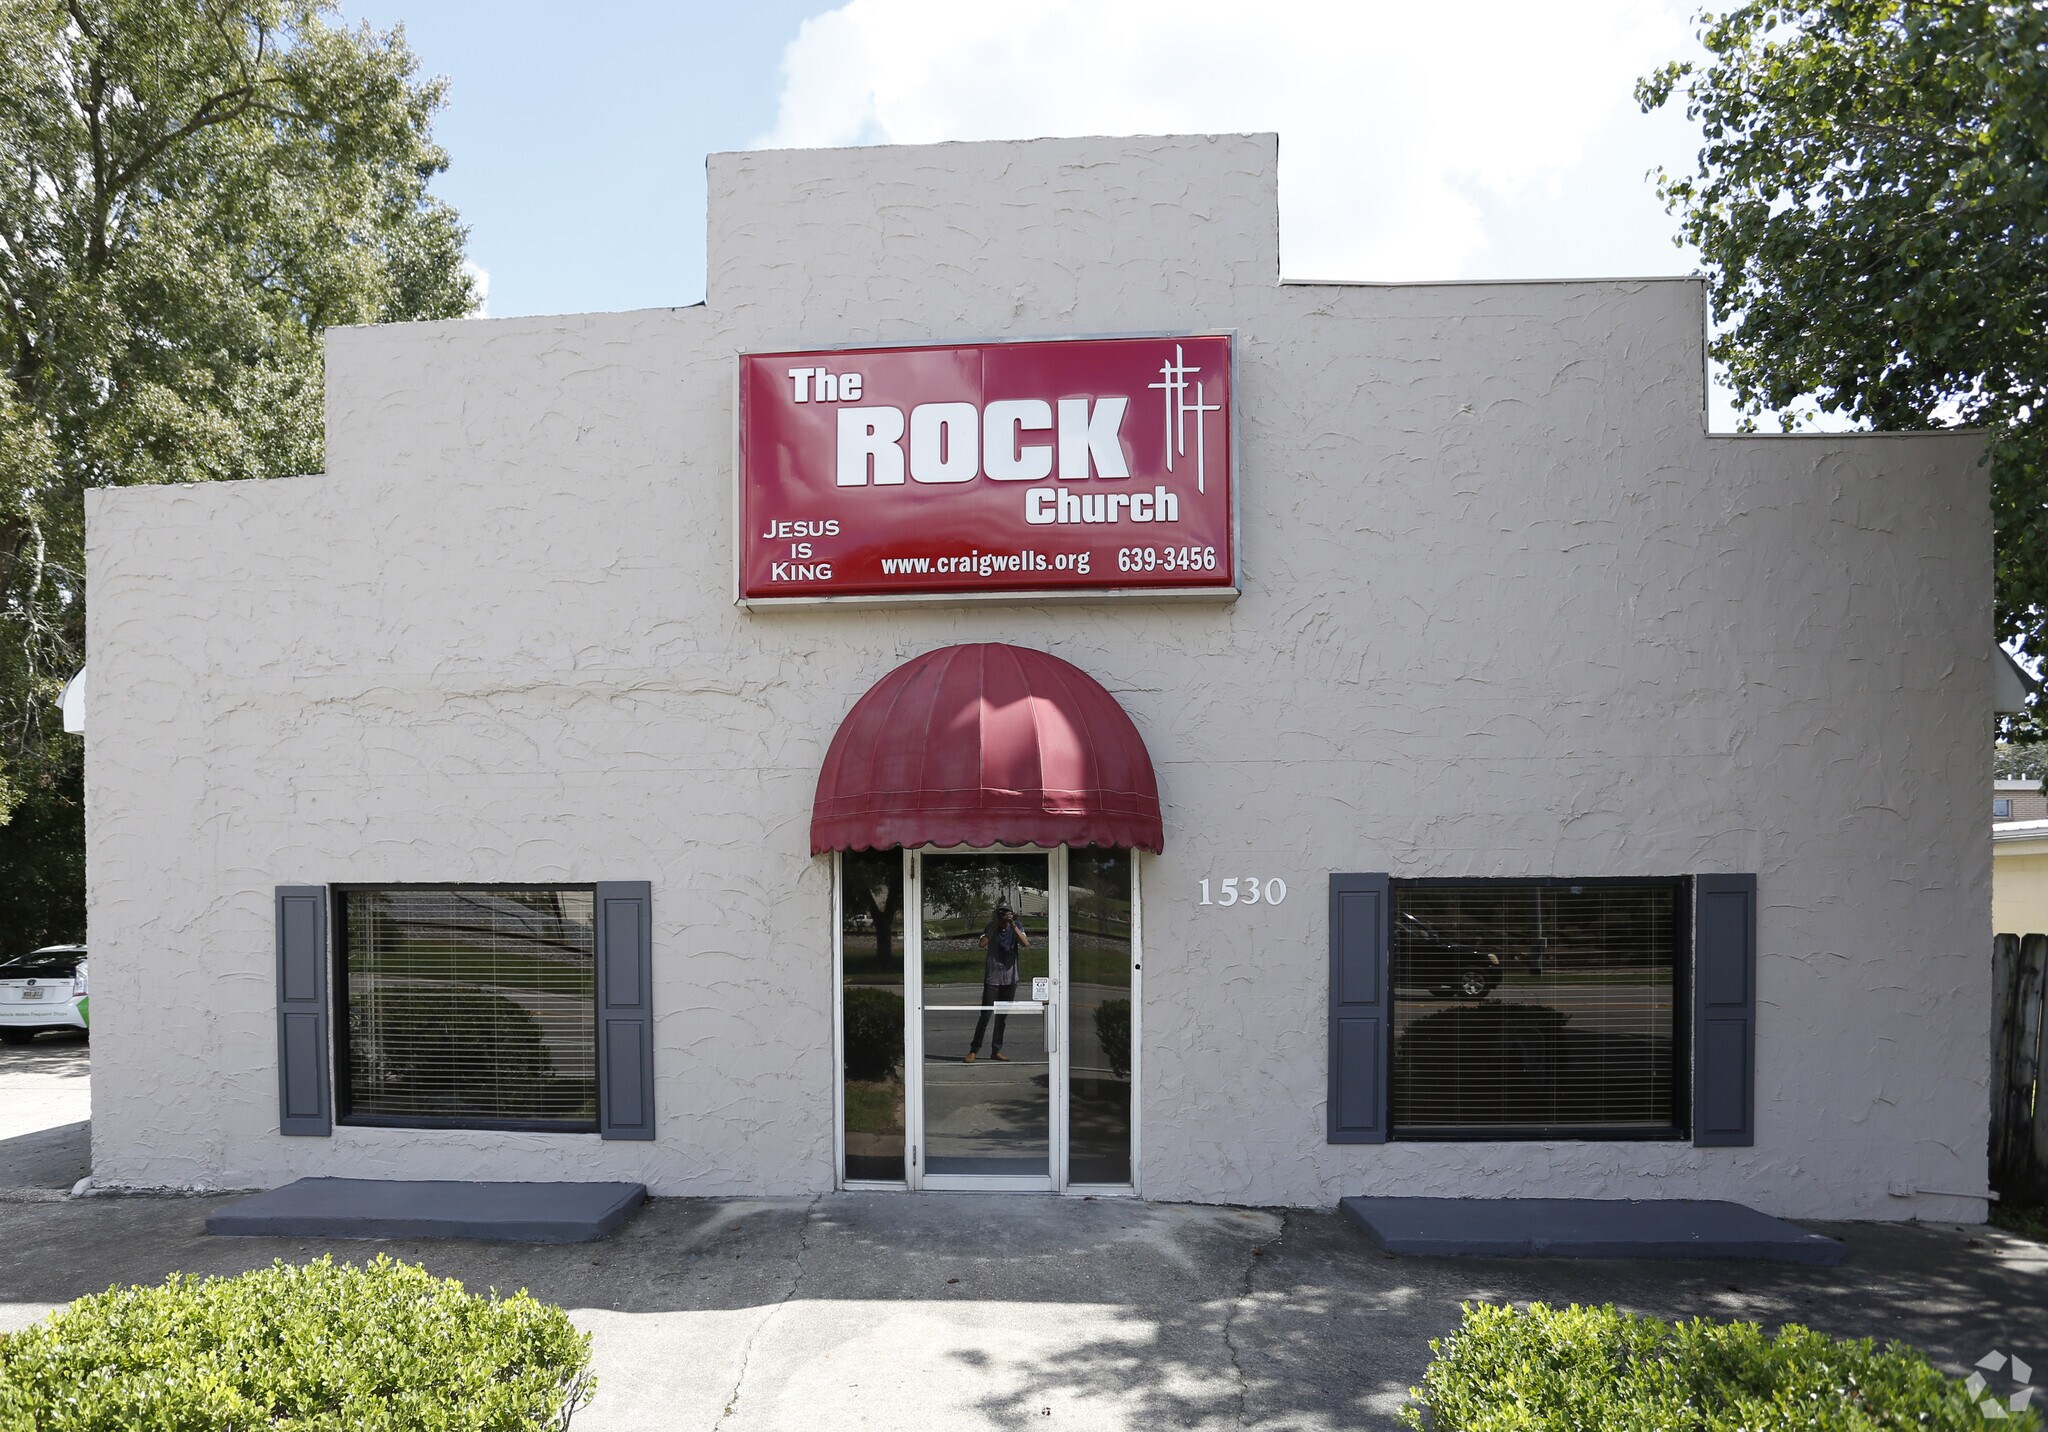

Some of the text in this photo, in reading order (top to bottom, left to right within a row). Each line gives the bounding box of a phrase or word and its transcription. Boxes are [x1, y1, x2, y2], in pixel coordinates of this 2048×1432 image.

[788, 367, 862, 403] The
[836, 396, 1131, 487] ROCK
[1025, 485, 1179, 525] Church
[763, 519, 840, 539] JESUS
[791, 542, 813, 559] IS
[881, 550, 1090, 577] www.craigwells.org
[1117, 546, 1216, 573] 639-3456
[771, 562, 832, 581] KING
[1198, 876, 1288, 906] 1530
